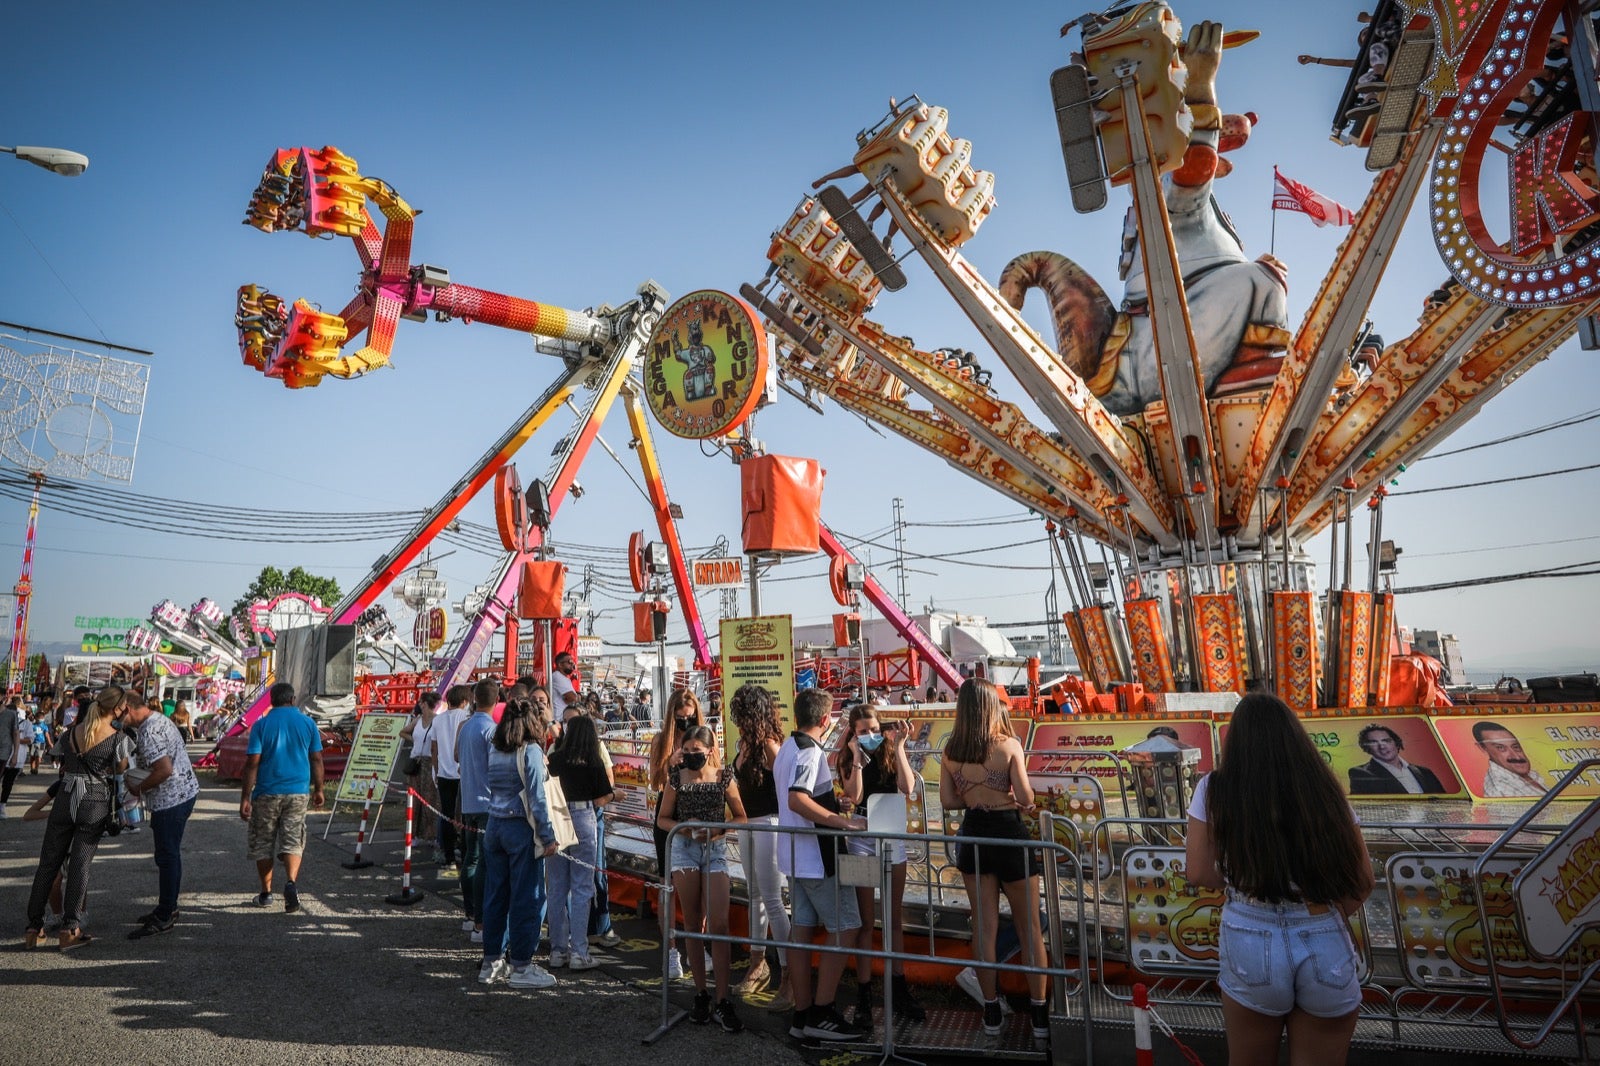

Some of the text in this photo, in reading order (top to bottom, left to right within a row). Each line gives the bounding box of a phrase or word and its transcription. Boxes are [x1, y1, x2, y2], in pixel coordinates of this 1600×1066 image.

[702, 303, 749, 419] KANGURO
[651, 338, 677, 410] MEGA
[695, 561, 742, 585] ENTRADA
[1057, 735, 1114, 746] EL MEGA
[1545, 727, 1569, 741] EL
